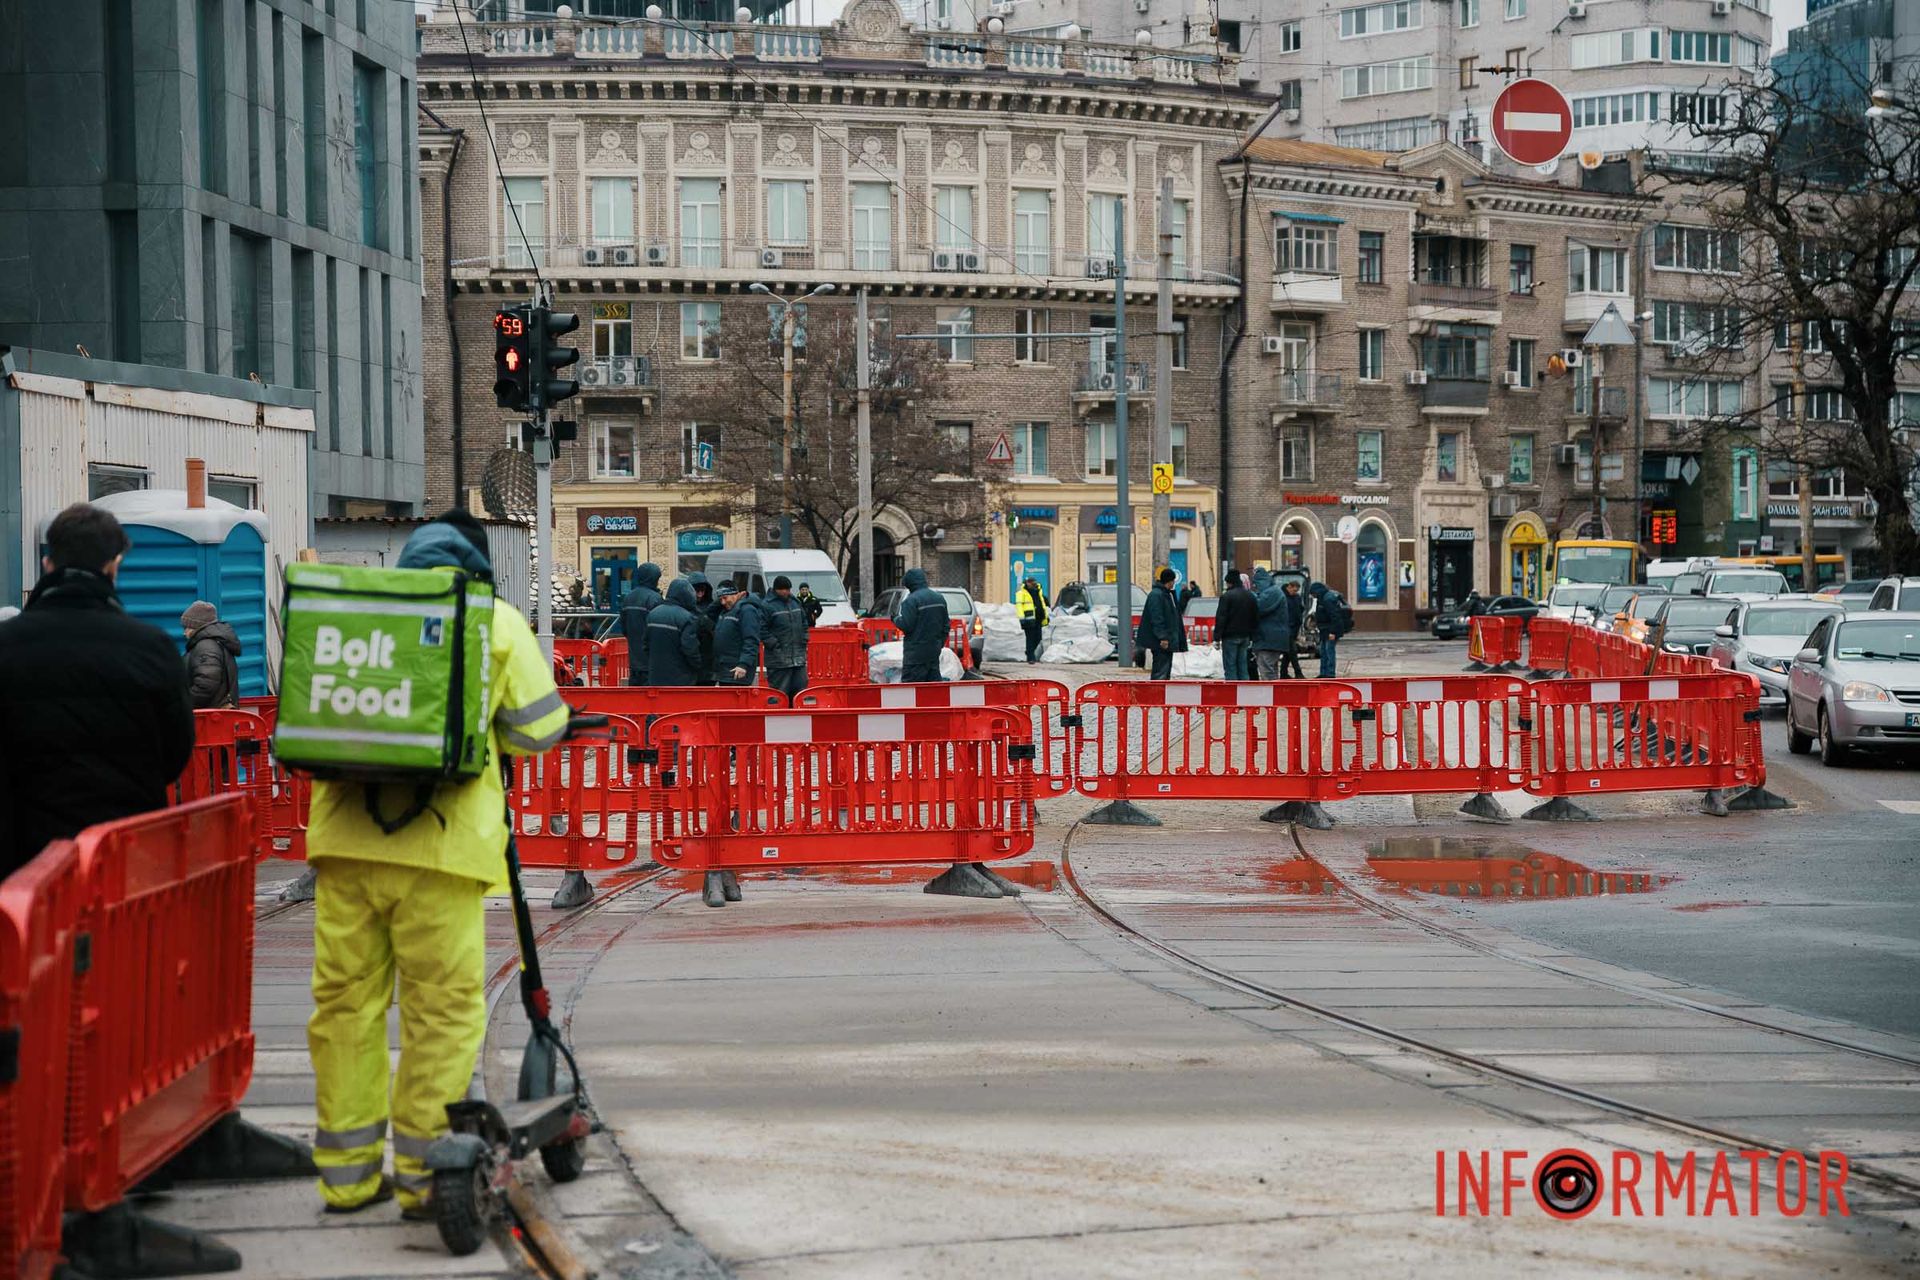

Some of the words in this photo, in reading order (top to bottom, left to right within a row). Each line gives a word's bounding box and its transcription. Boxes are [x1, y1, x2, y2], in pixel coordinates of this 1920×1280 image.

[502, 318, 523, 335] 59
[604, 516, 637, 525] МИР
[314, 625, 396, 676] Bolt
[309, 674, 412, 718] Food
